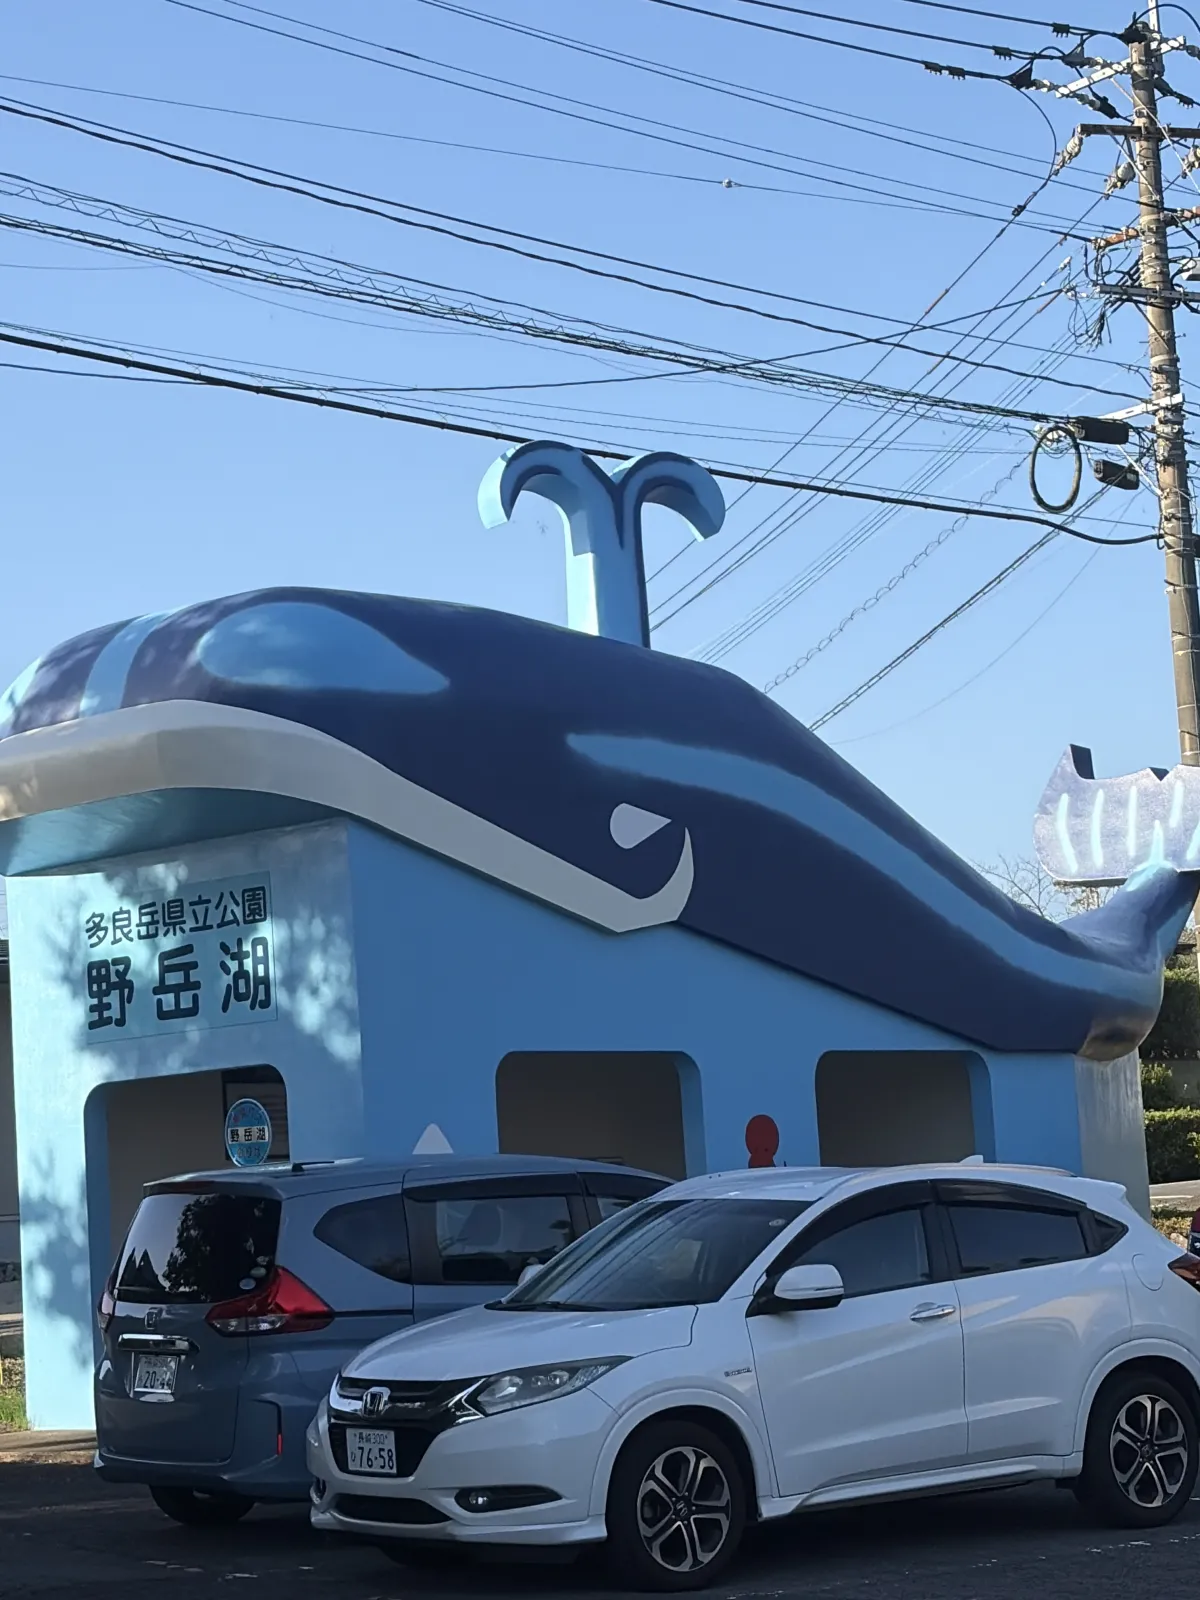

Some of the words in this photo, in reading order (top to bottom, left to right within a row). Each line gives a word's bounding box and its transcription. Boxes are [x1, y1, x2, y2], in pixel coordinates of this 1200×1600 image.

[85, 886, 268, 948] 多良岳県立公園
[87, 936, 271, 1031] 野岳湖
[230, 1127, 266, 1142] 野岳湖
[358, 1446, 394, 1470] 76-58
